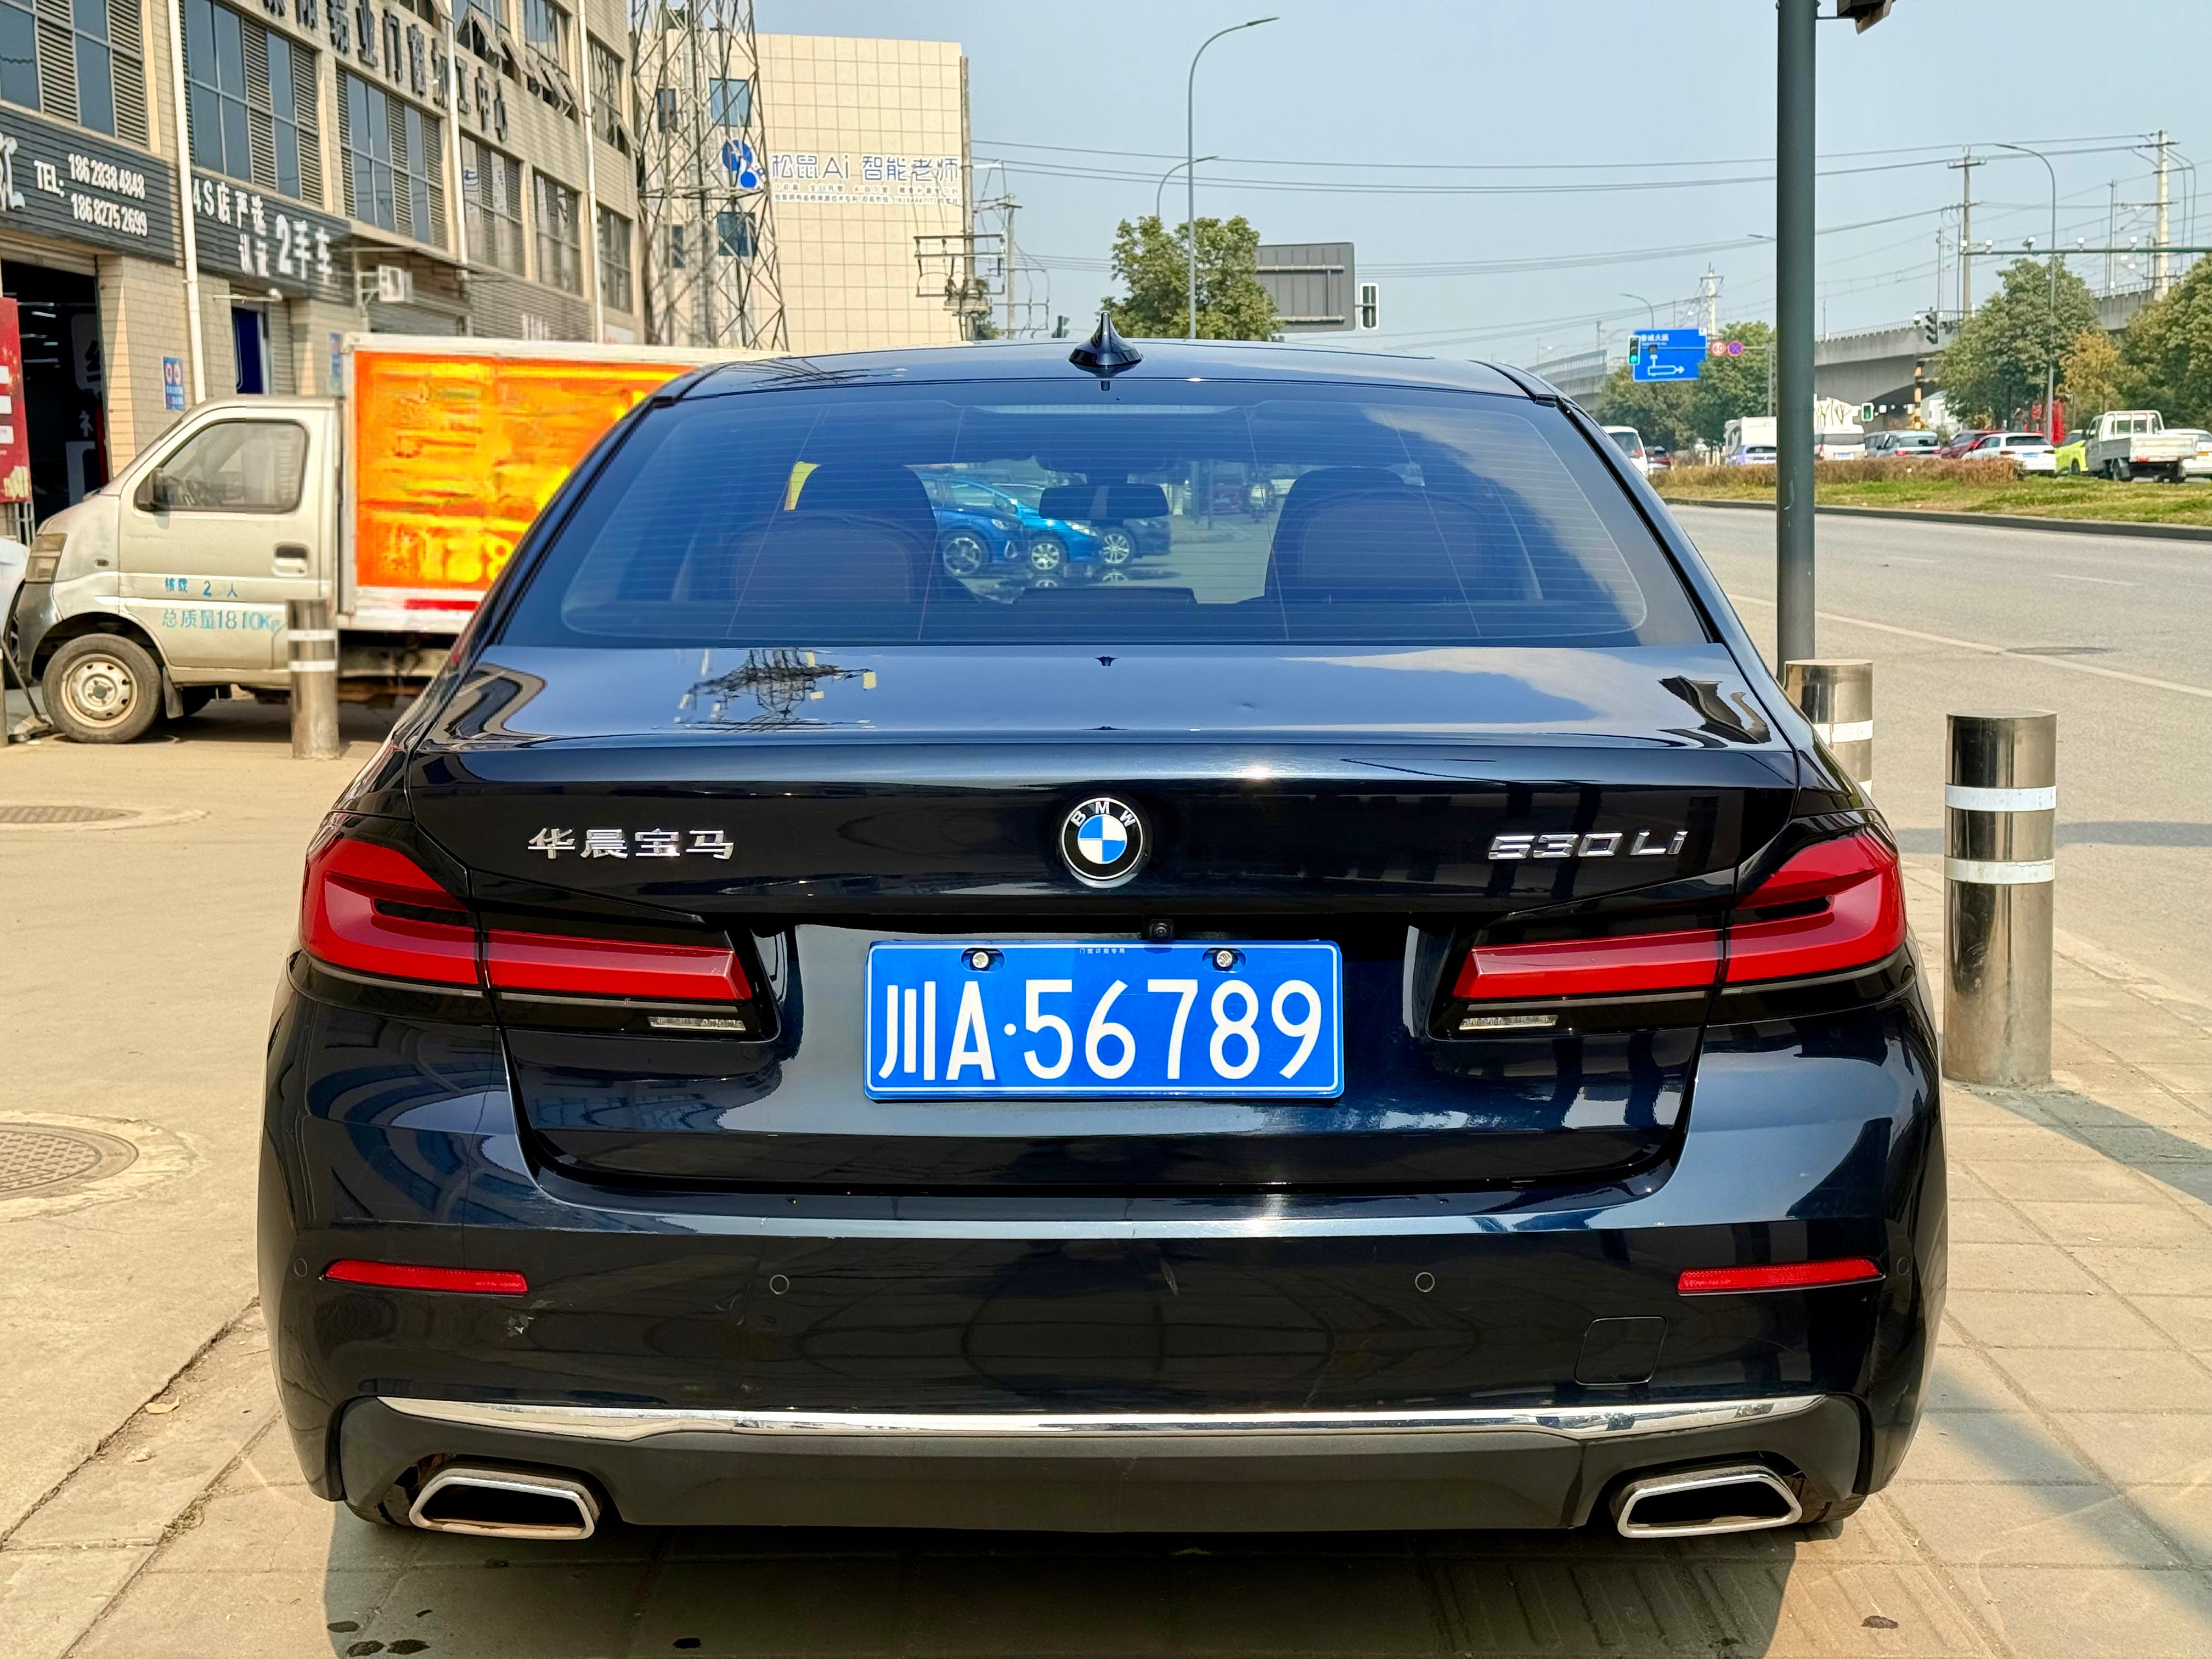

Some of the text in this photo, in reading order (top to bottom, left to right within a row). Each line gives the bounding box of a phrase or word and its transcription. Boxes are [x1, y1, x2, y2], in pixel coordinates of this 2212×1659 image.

[33, 160, 65, 198] TEL:
[772, 155, 958, 182] 松鼠Ai 智能老师
[1713, 345, 1724, 353] 60
[202, 580, 212, 597] 2
[227, 583, 238, 598] 人
[1070, 802, 1136, 827] BMW
[527, 827, 734, 860] 华晨宝马
[878, 979, 1322, 1081] 川A·56789
